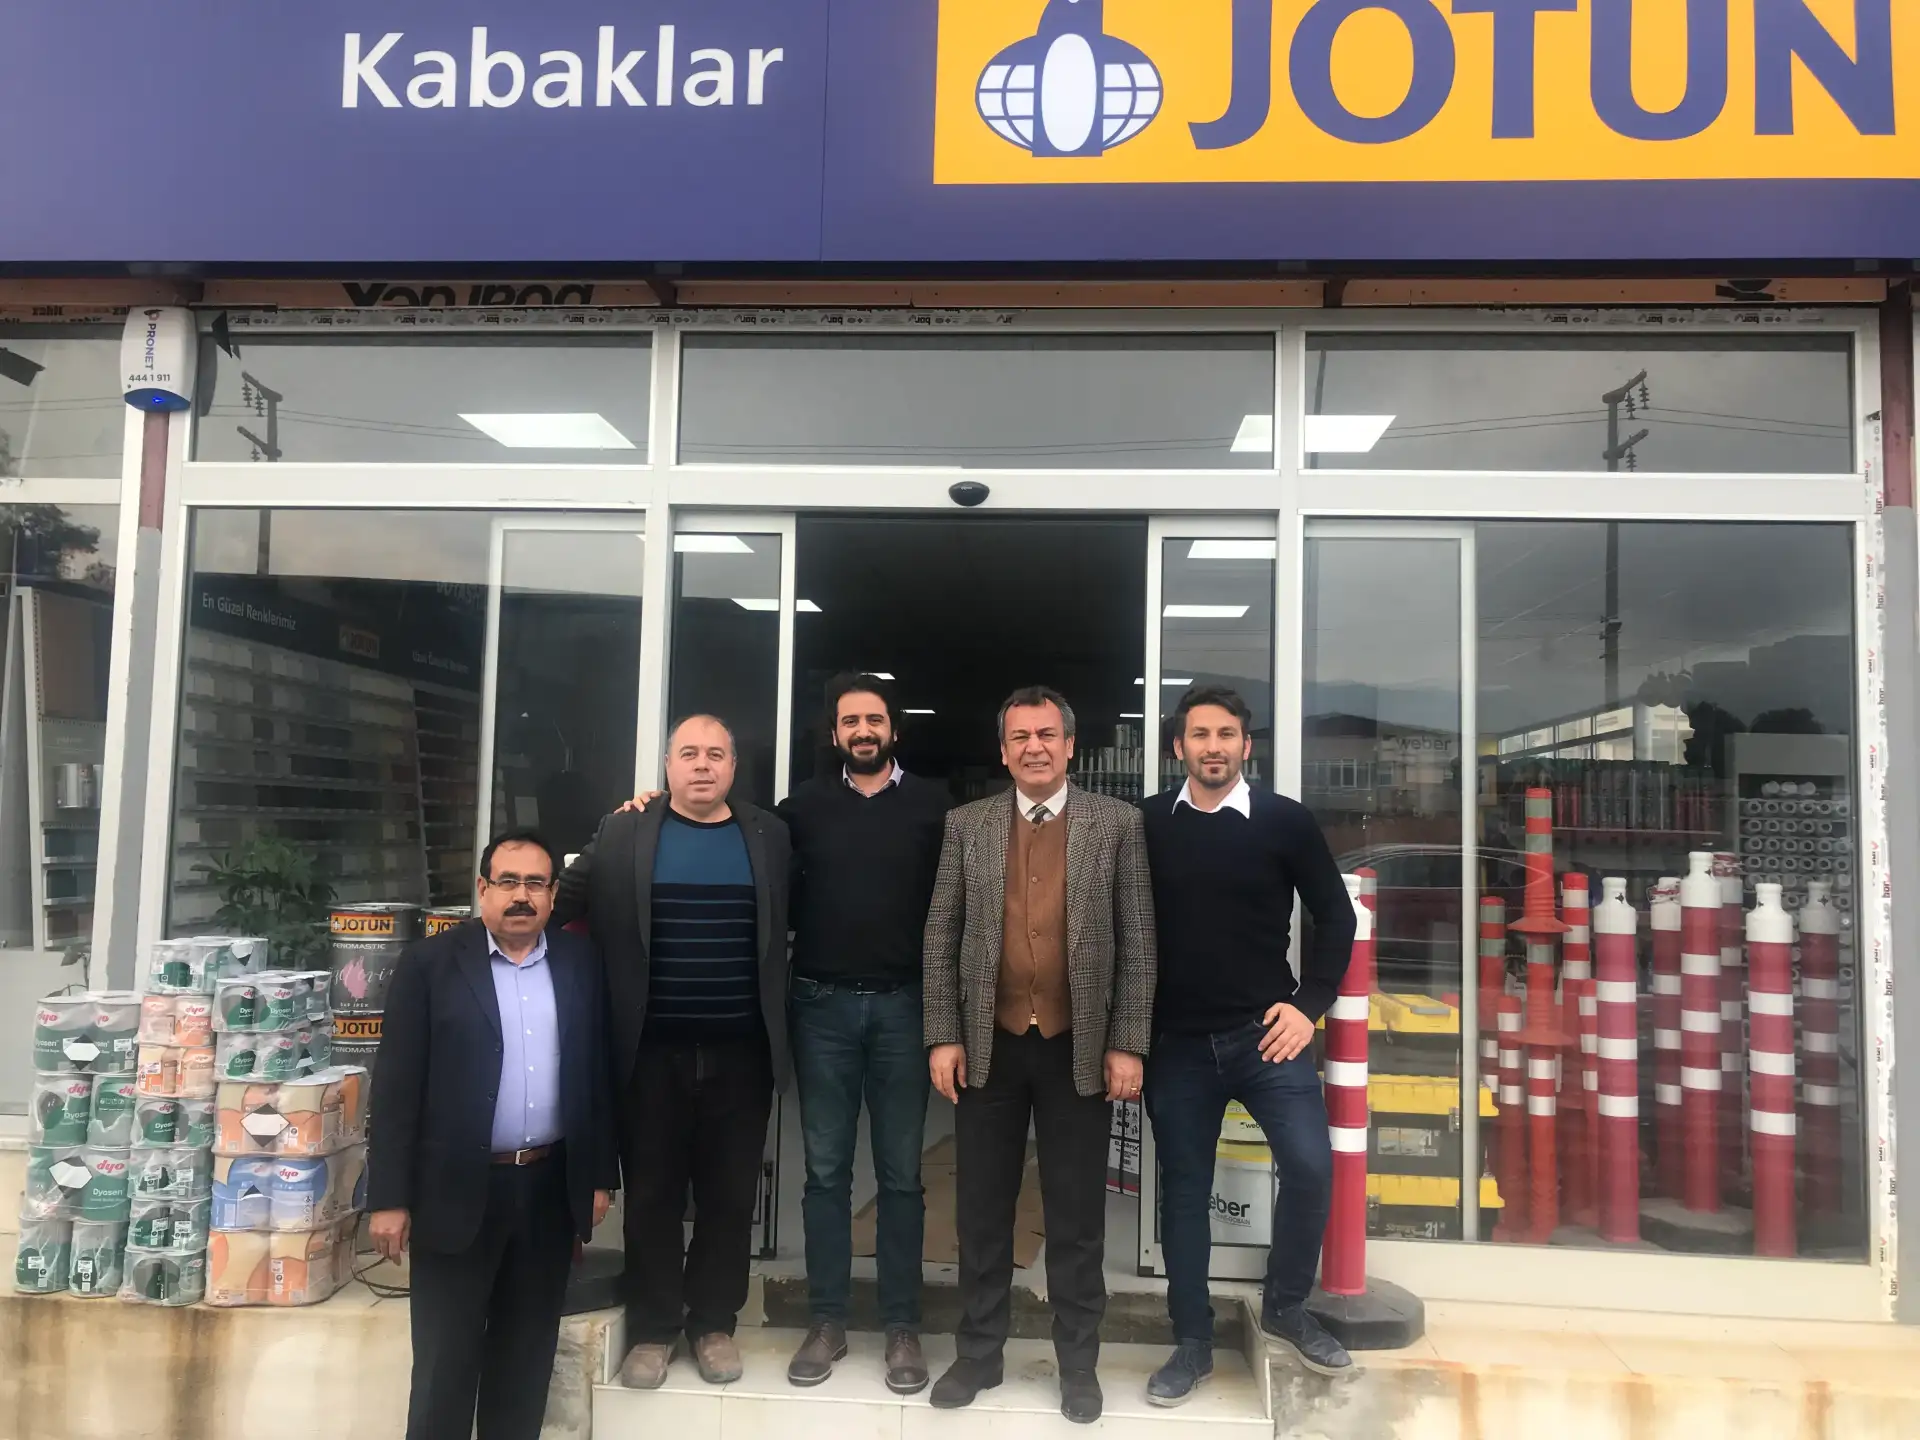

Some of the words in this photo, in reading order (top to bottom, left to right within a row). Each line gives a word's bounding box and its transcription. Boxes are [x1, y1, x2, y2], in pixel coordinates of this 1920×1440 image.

[341, 25, 784, 108] Kabaklar
[1187, 0, 1895, 149] JOTUN
[144, 322, 157, 371] PRONET
[128, 373, 148, 382] 444
[156, 373, 171, 382] 911
[202, 592, 215, 609] En
[217, 595, 245, 617] Güzel
[246, 603, 297, 631] Renklerimiz
[341, 918, 391, 932] JOTUN
[333, 942, 387, 950] FENOMASTIC
[340, 1022, 383, 1035] JOTU
[1245, 1120, 1261, 1129] web
[96, 1159, 126, 1173] dyo
[92, 1187, 123, 1197] Dyosen
